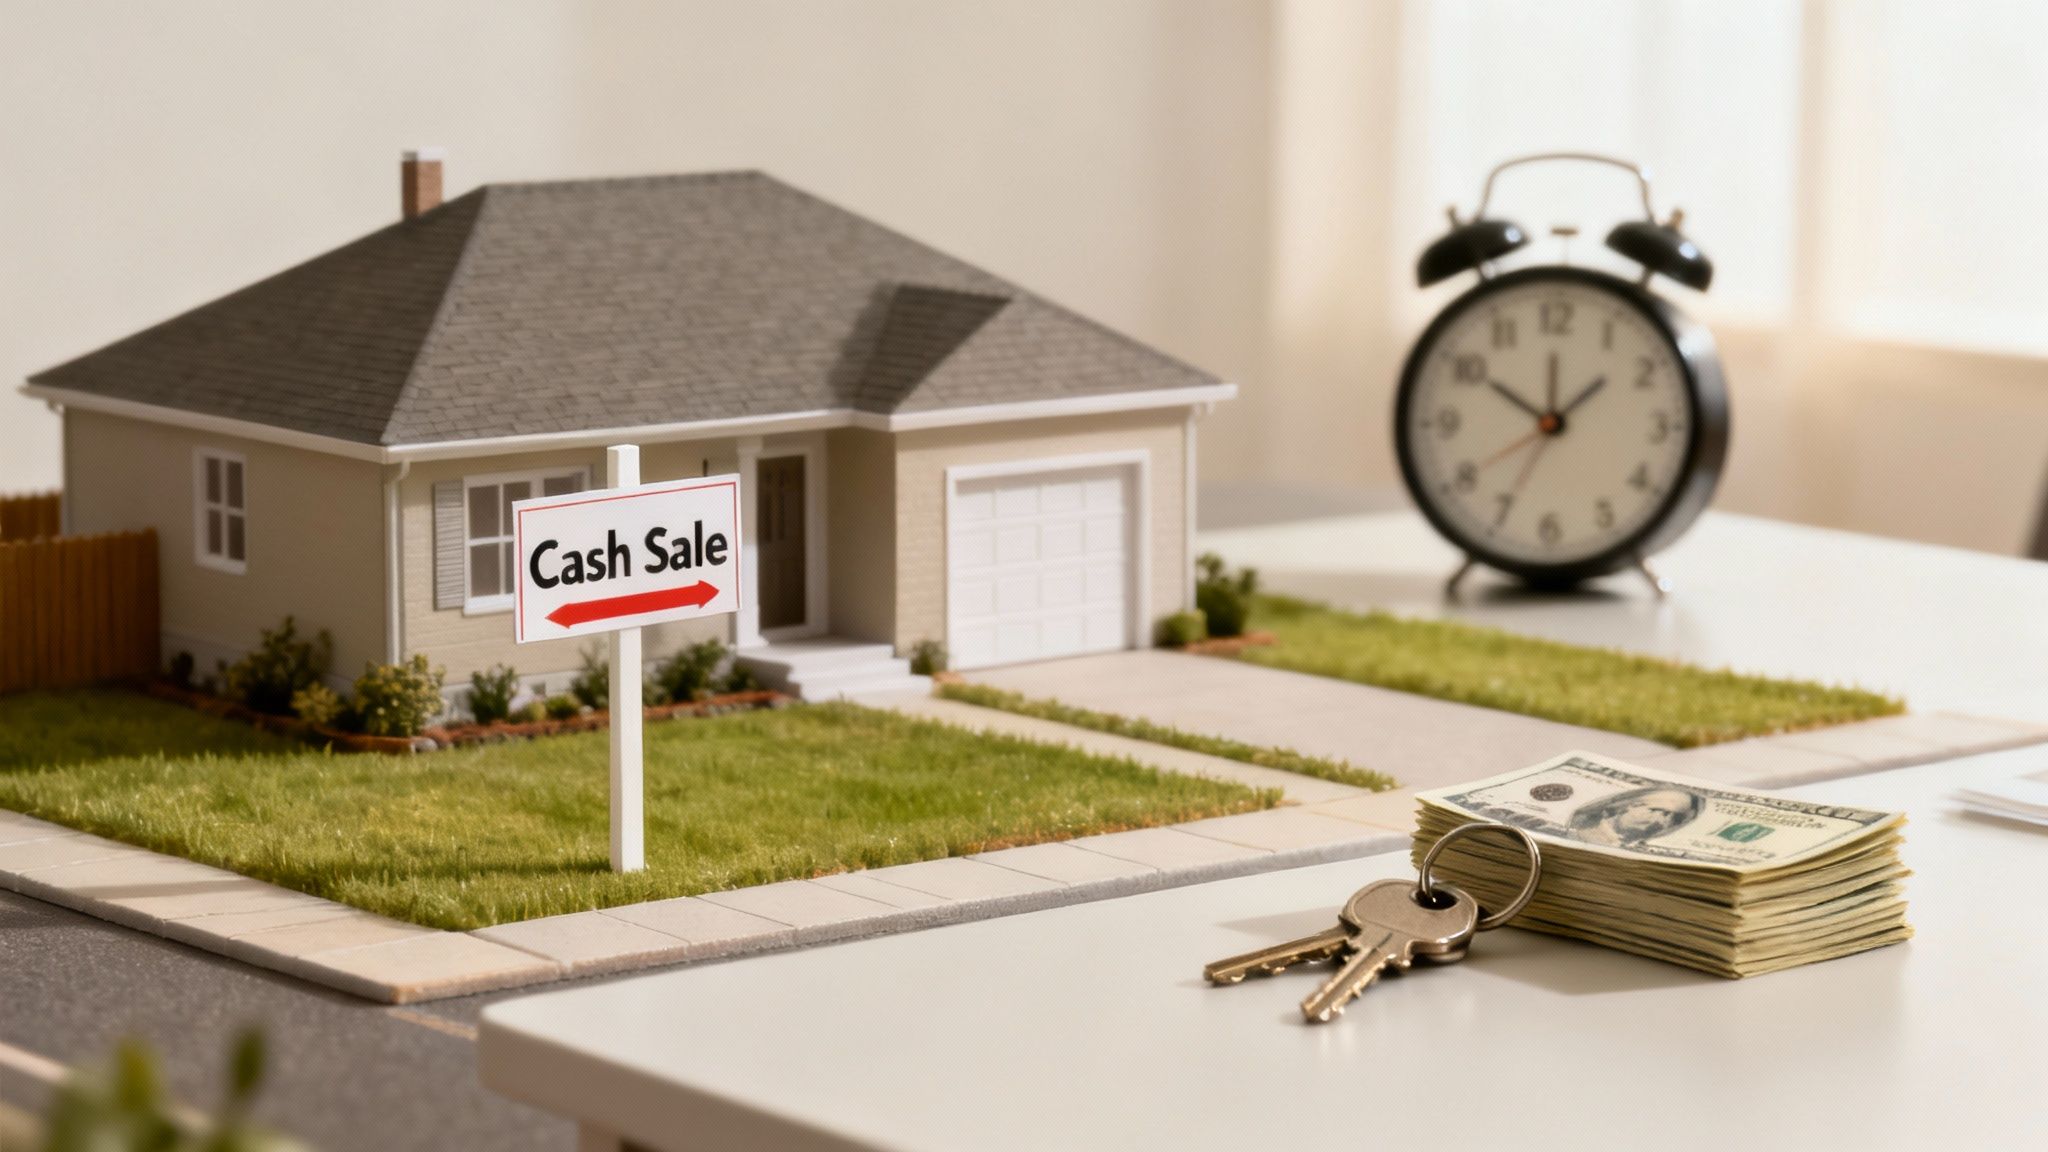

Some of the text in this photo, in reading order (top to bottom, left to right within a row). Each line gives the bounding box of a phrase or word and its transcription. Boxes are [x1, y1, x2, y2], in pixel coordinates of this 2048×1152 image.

[1491, 319, 1517, 348] 11
[1540, 302, 1574, 335] 12
[1603, 319, 1615, 350] 1
[1453, 354, 1488, 385] 10
[1634, 357, 1654, 389] 2
[1438, 406, 1460, 439] 9
[1648, 411, 1669, 444] 3
[1456, 462, 1478, 493] 8
[1627, 462, 1649, 490] 4
[1495, 493, 1513, 526] 7
[1596, 499, 1615, 529] 5
[1538, 513, 1563, 544] 6
[530, 520, 728, 589] Cash Sale
